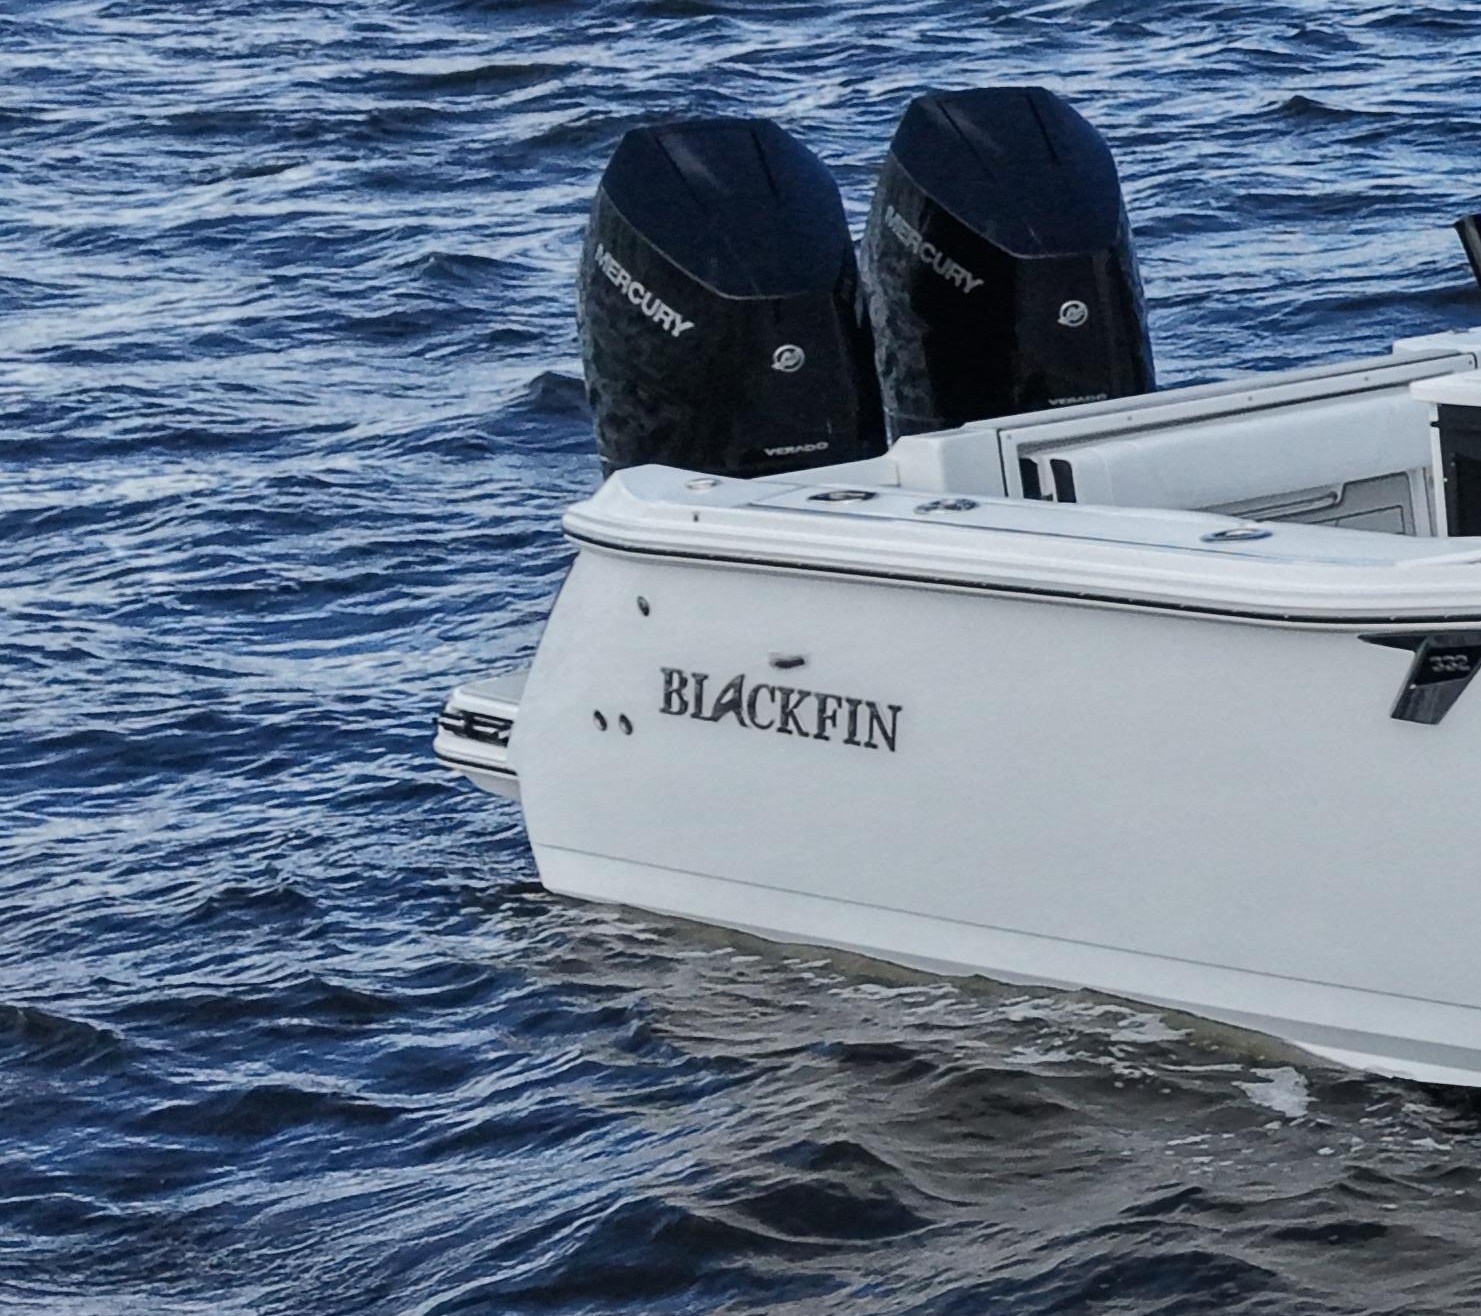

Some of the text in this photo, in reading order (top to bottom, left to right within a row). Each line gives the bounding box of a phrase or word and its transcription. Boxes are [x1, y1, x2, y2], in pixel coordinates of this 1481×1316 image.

[595, 243, 694, 337] MERCURY
[885, 205, 984, 293] MERCURY
[764, 441, 829, 456] VERADO
[1429, 654, 1470, 672] 332
[659, 666, 903, 752] BLACKFIN
